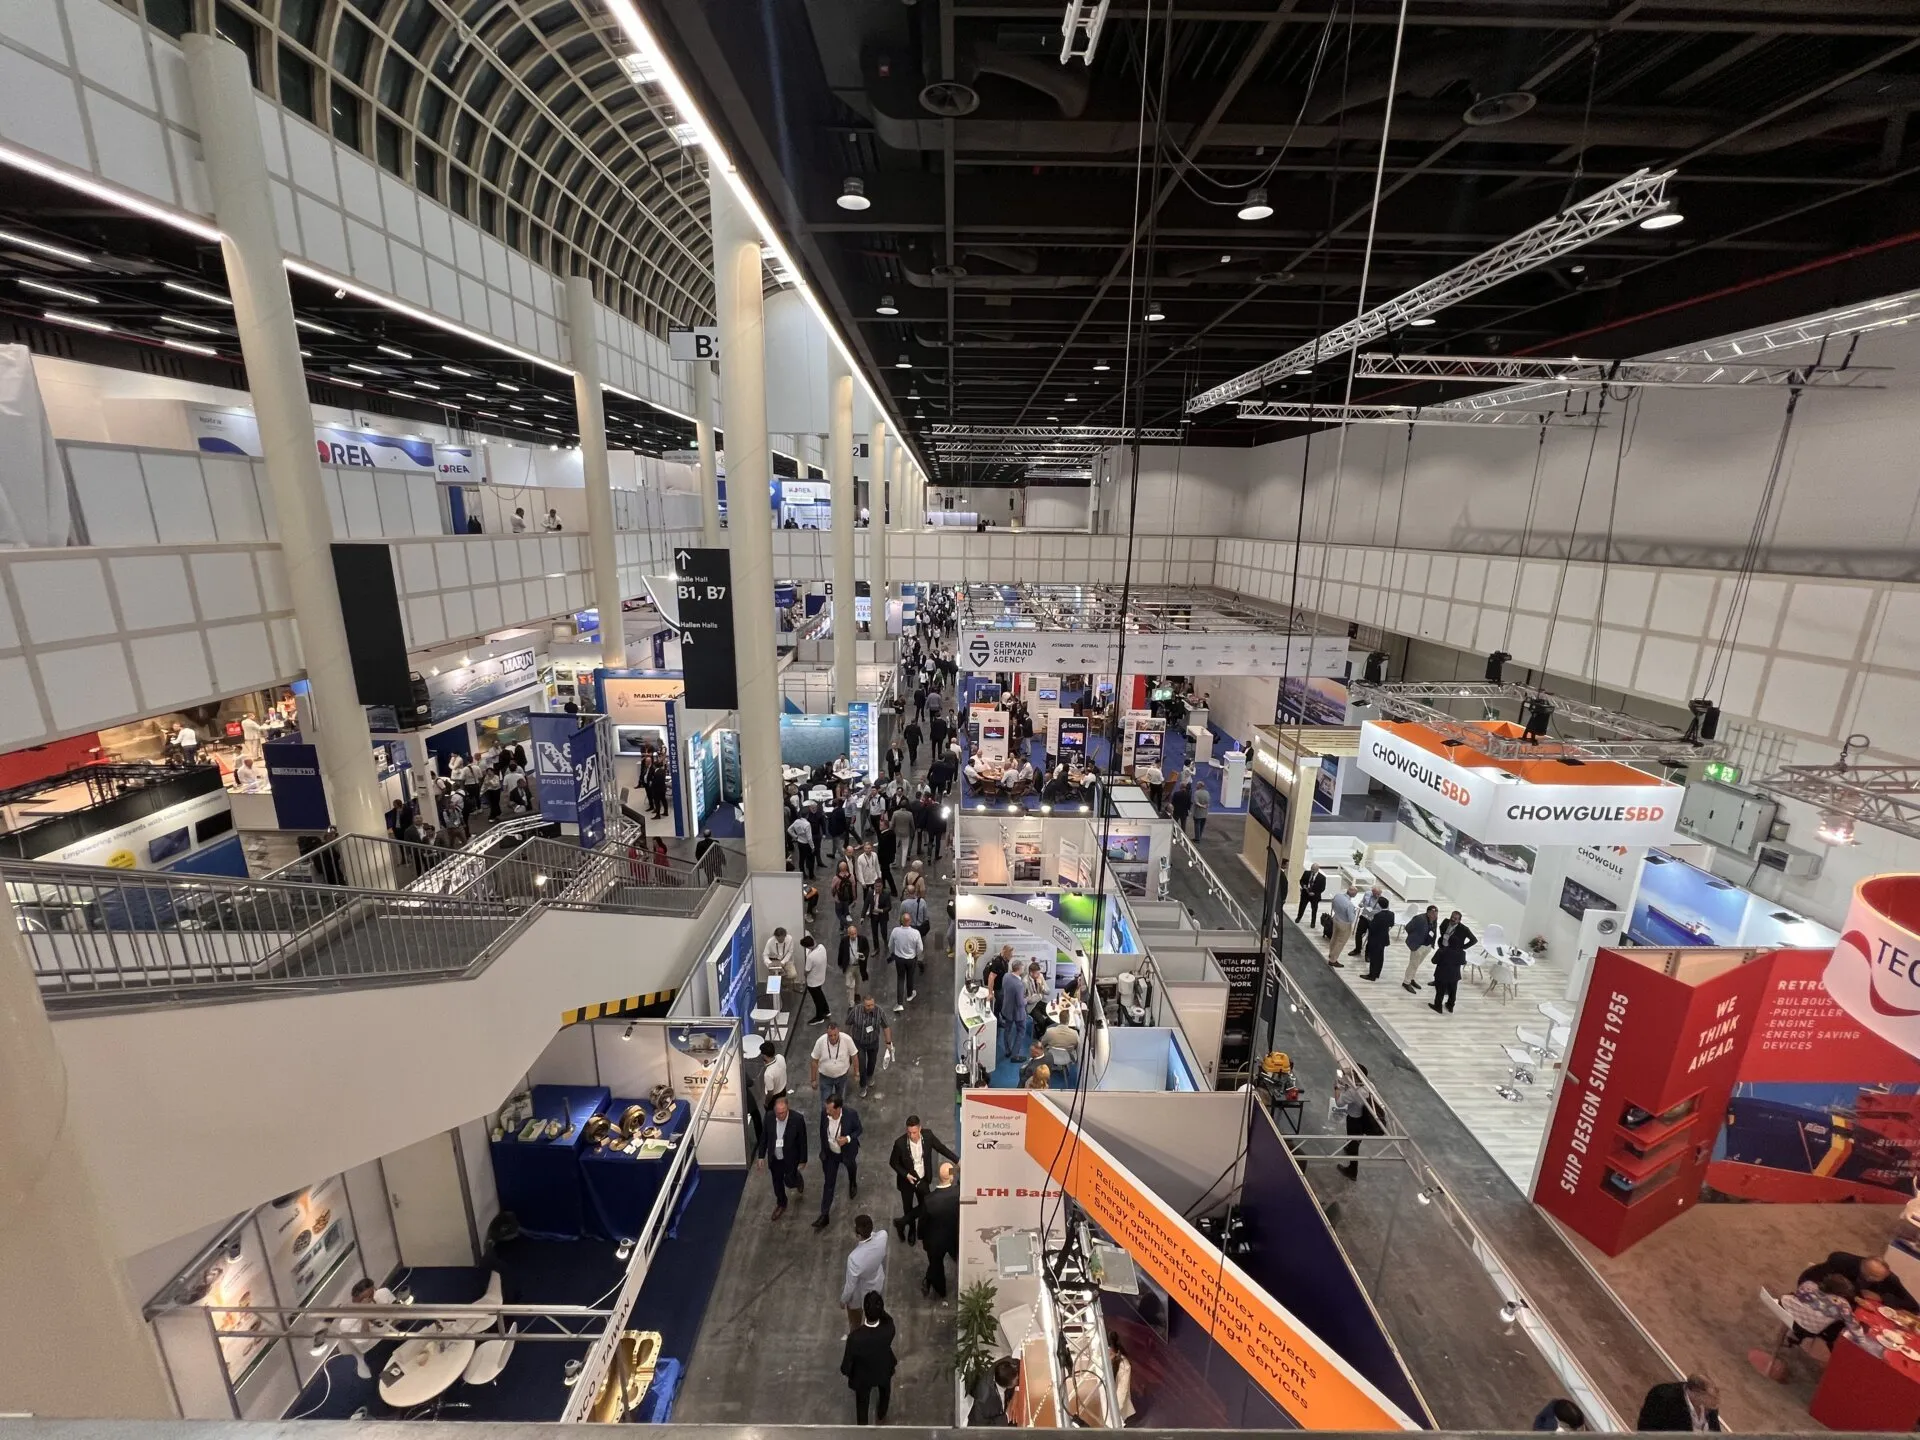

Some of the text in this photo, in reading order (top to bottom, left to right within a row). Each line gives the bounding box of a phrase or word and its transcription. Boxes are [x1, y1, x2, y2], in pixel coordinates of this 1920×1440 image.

[316, 439, 376, 468] OREA
[677, 585, 726, 601] B1, B7
[680, 621, 718, 629] Hallen Halls
[681, 631, 694, 645] A
[993, 640, 1037, 649] GERMANIA
[992, 656, 1026, 664] AGENCY
[993, 648, 1034, 657] SHIPYARD
[502, 650, 534, 676] MARIN
[1372, 742, 1471, 807] CHOWGULESBD
[1506, 804, 1664, 822] CHOWGULESBD
[62, 836, 113, 861] Empowering
[1577, 846, 1624, 875] CHOWGULE
[1001, 908, 1034, 924] PROMAR
[1716, 995, 1738, 1019] WE
[1769, 1008, 1844, 1017] -PROPELLER
[1698, 1014, 1741, 1048] THINK
[1765, 1019, 1816, 1028] -ENGINE
[1761, 1030, 1861, 1040] -ENERGY SAVING
[1762, 1041, 1813, 1050] DEVICES
[1687, 1037, 1735, 1074] AHEAD.
[1560, 991, 1630, 1195] SHIP DESIGN SINCE 1955
[981, 1122, 1011, 1130] HEMOS
[976, 1187, 1063, 1198] LTH Baas
[1096, 1168, 1317, 1379] Reliable partner for complex projects
[1095, 1183, 1307, 1390] Energy optimization through retrofit
[1094, 1197, 1123, 1230] Smart
[1125, 1226, 1169, 1275] Interiors
[1246, 1345, 1309, 1410] Services
[601, 1297, 631, 1365] TAIWAN
